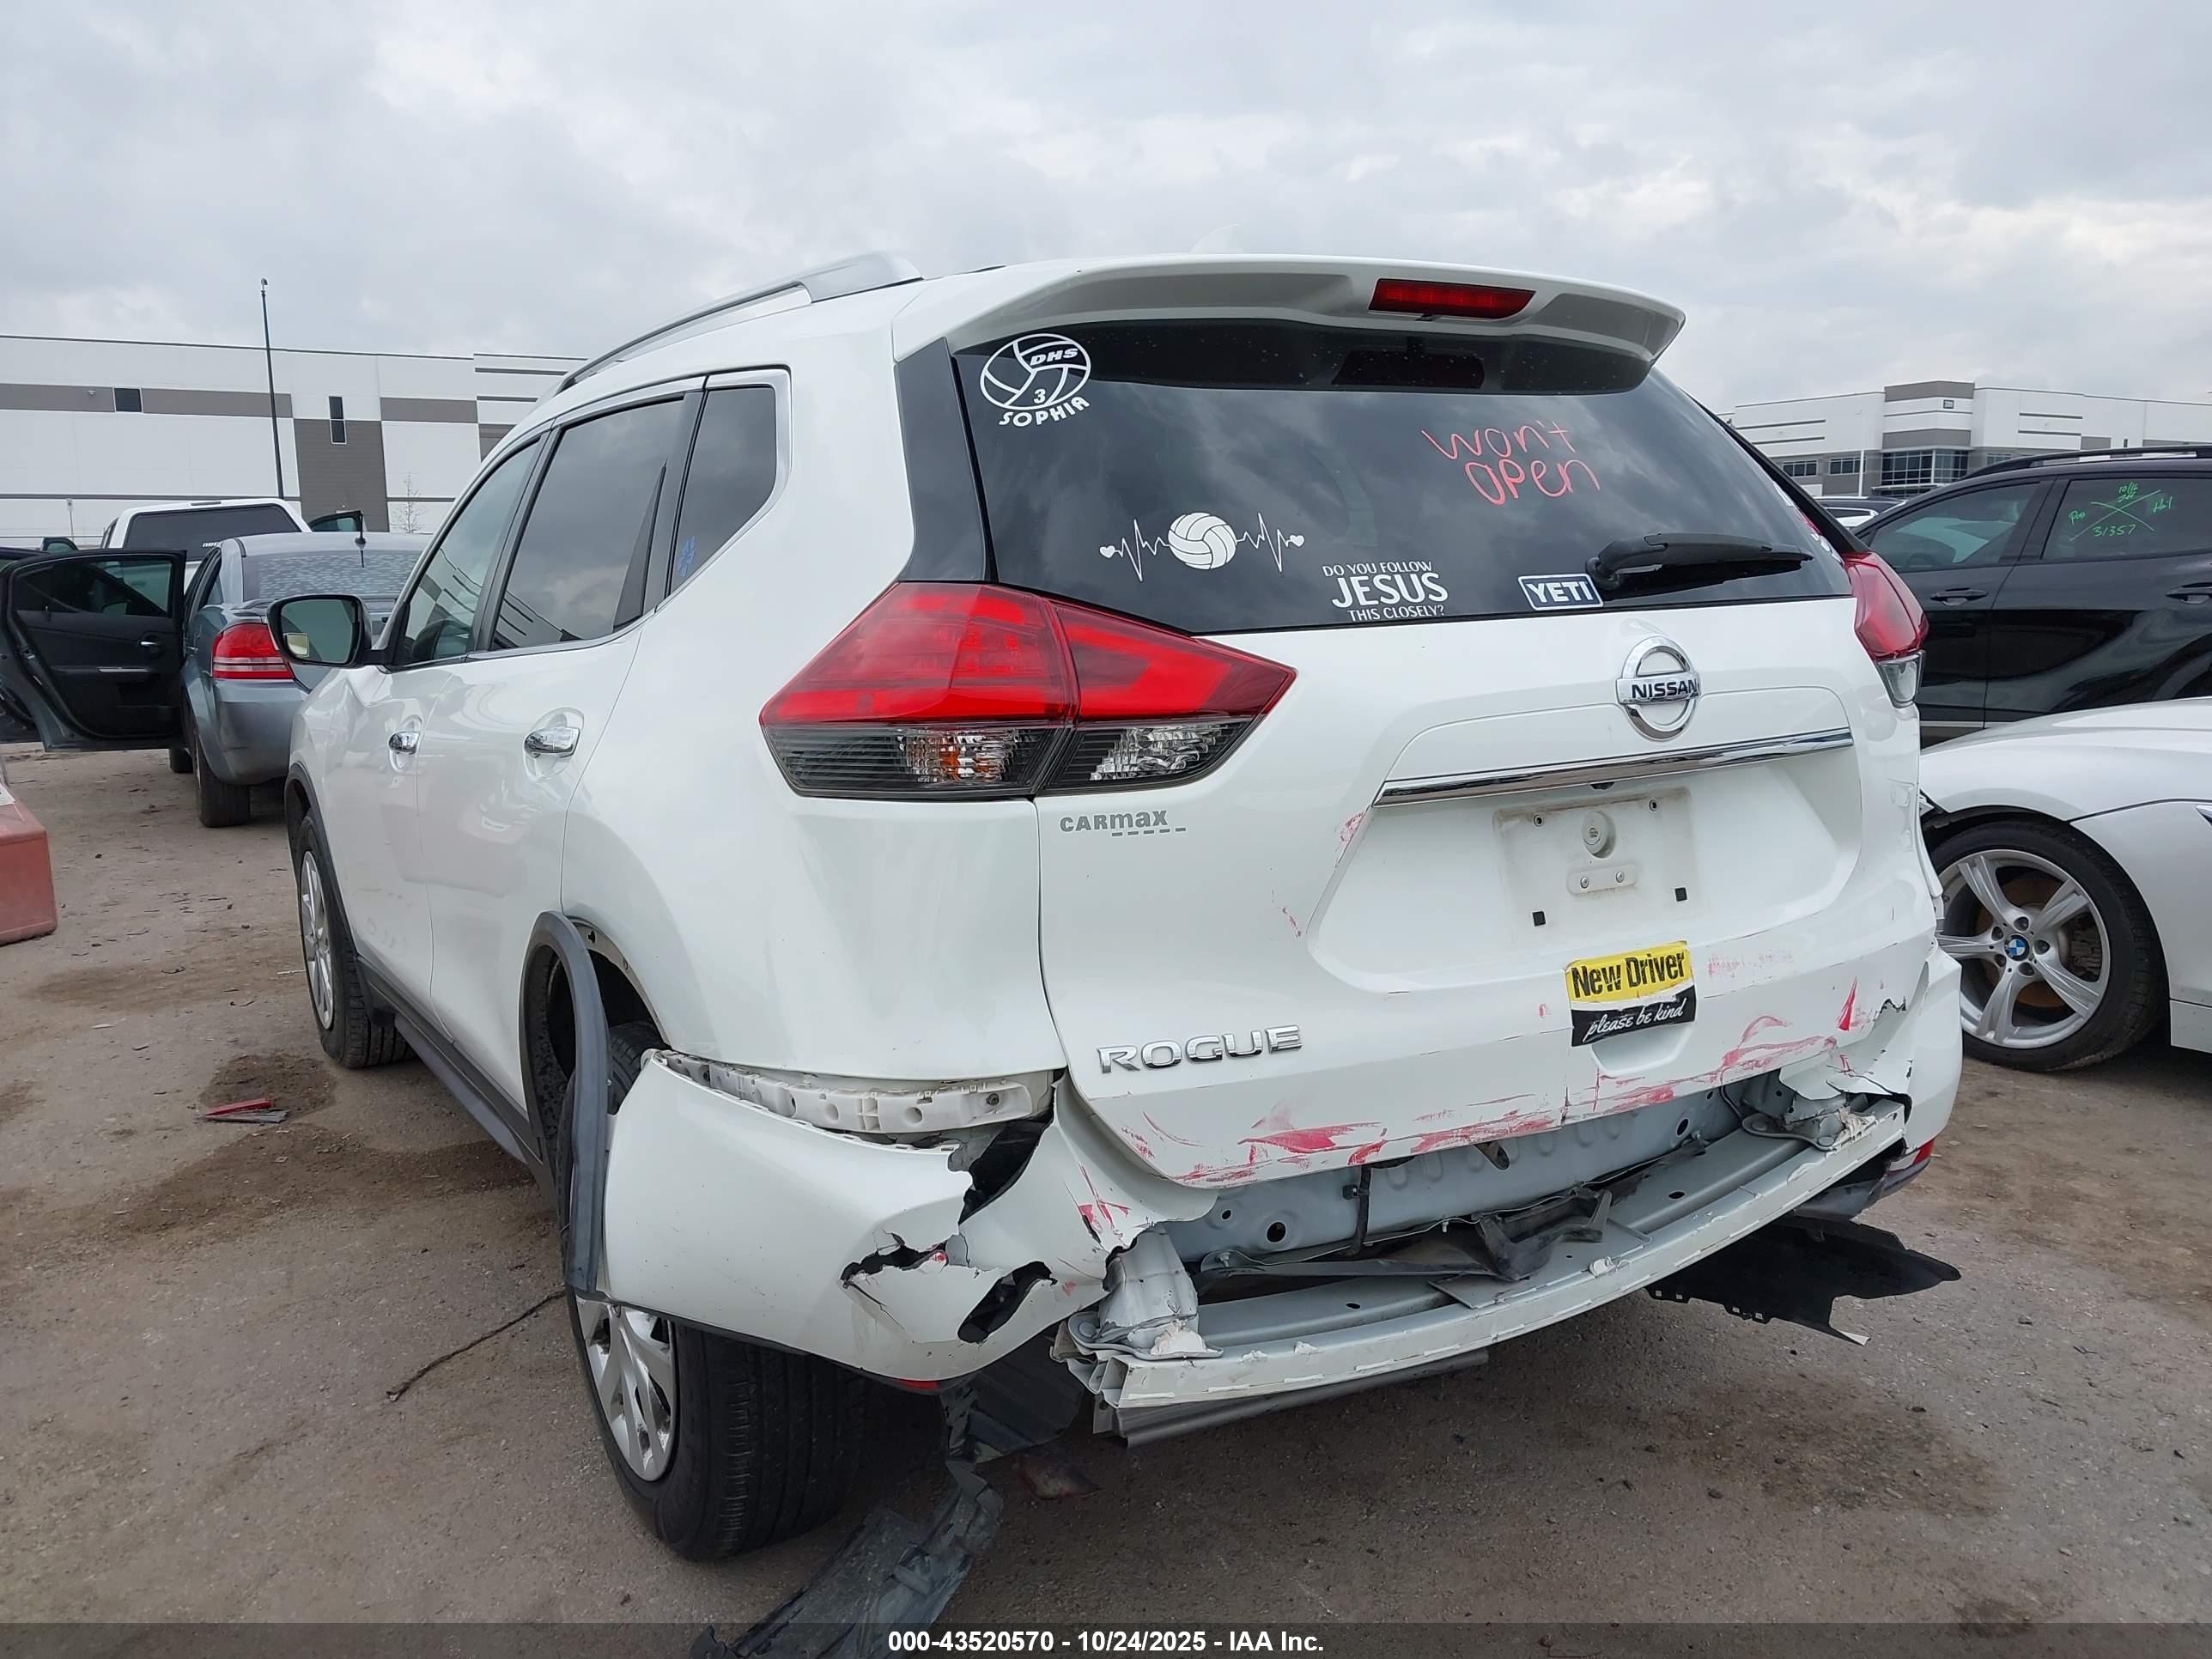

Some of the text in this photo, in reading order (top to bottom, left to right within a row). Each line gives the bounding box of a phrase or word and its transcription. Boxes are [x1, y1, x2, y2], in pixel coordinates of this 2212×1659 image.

[1030, 348, 1079, 366] DHS
[1033, 388, 1047, 404] 3
[999, 397, 1091, 427] SOPHIA
[2092, 524, 2136, 538] 31357
[1322, 561, 1432, 577] DO YOU FOLLOW
[1332, 572, 1449, 608] JESUS
[1525, 580, 1594, 603] YETI
[1346, 604, 1445, 623] THIS CLOSELY?
[1631, 678, 1698, 699] NISSAN
[1570, 951, 1686, 999] New Driver
[1582, 997, 1688, 1043] please be kind
[1097, 1024, 1304, 1074] ROGUE
